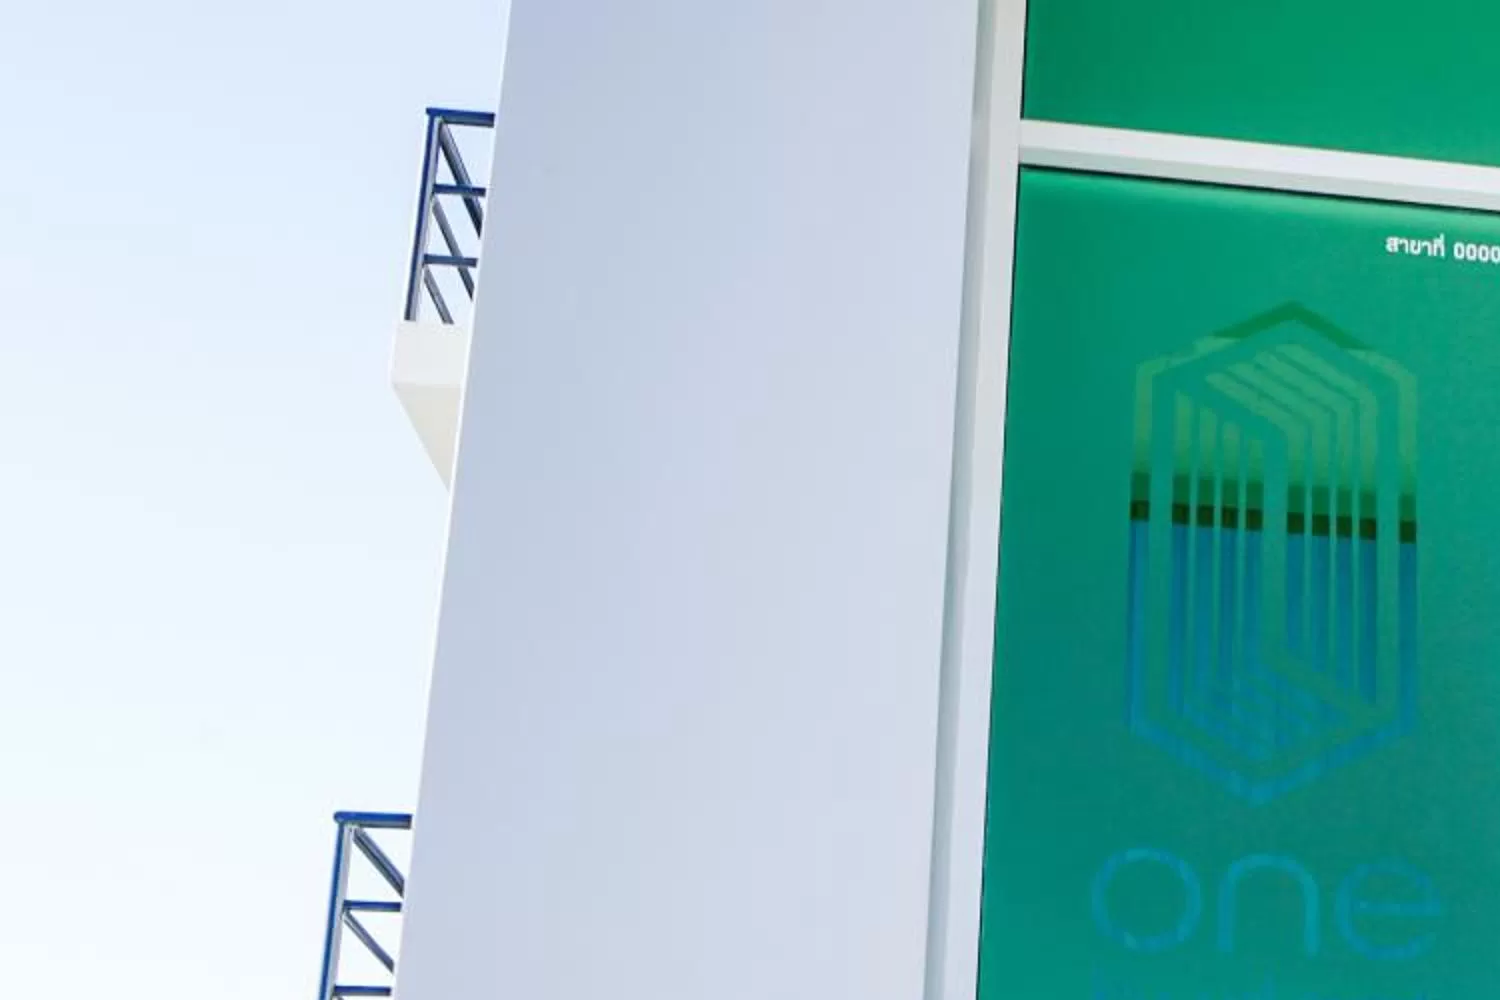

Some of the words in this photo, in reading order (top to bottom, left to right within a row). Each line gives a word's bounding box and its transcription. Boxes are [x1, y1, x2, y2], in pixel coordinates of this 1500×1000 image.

[1385, 233, 1445, 259] สาขาที่
[1090, 846, 1441, 960] one
